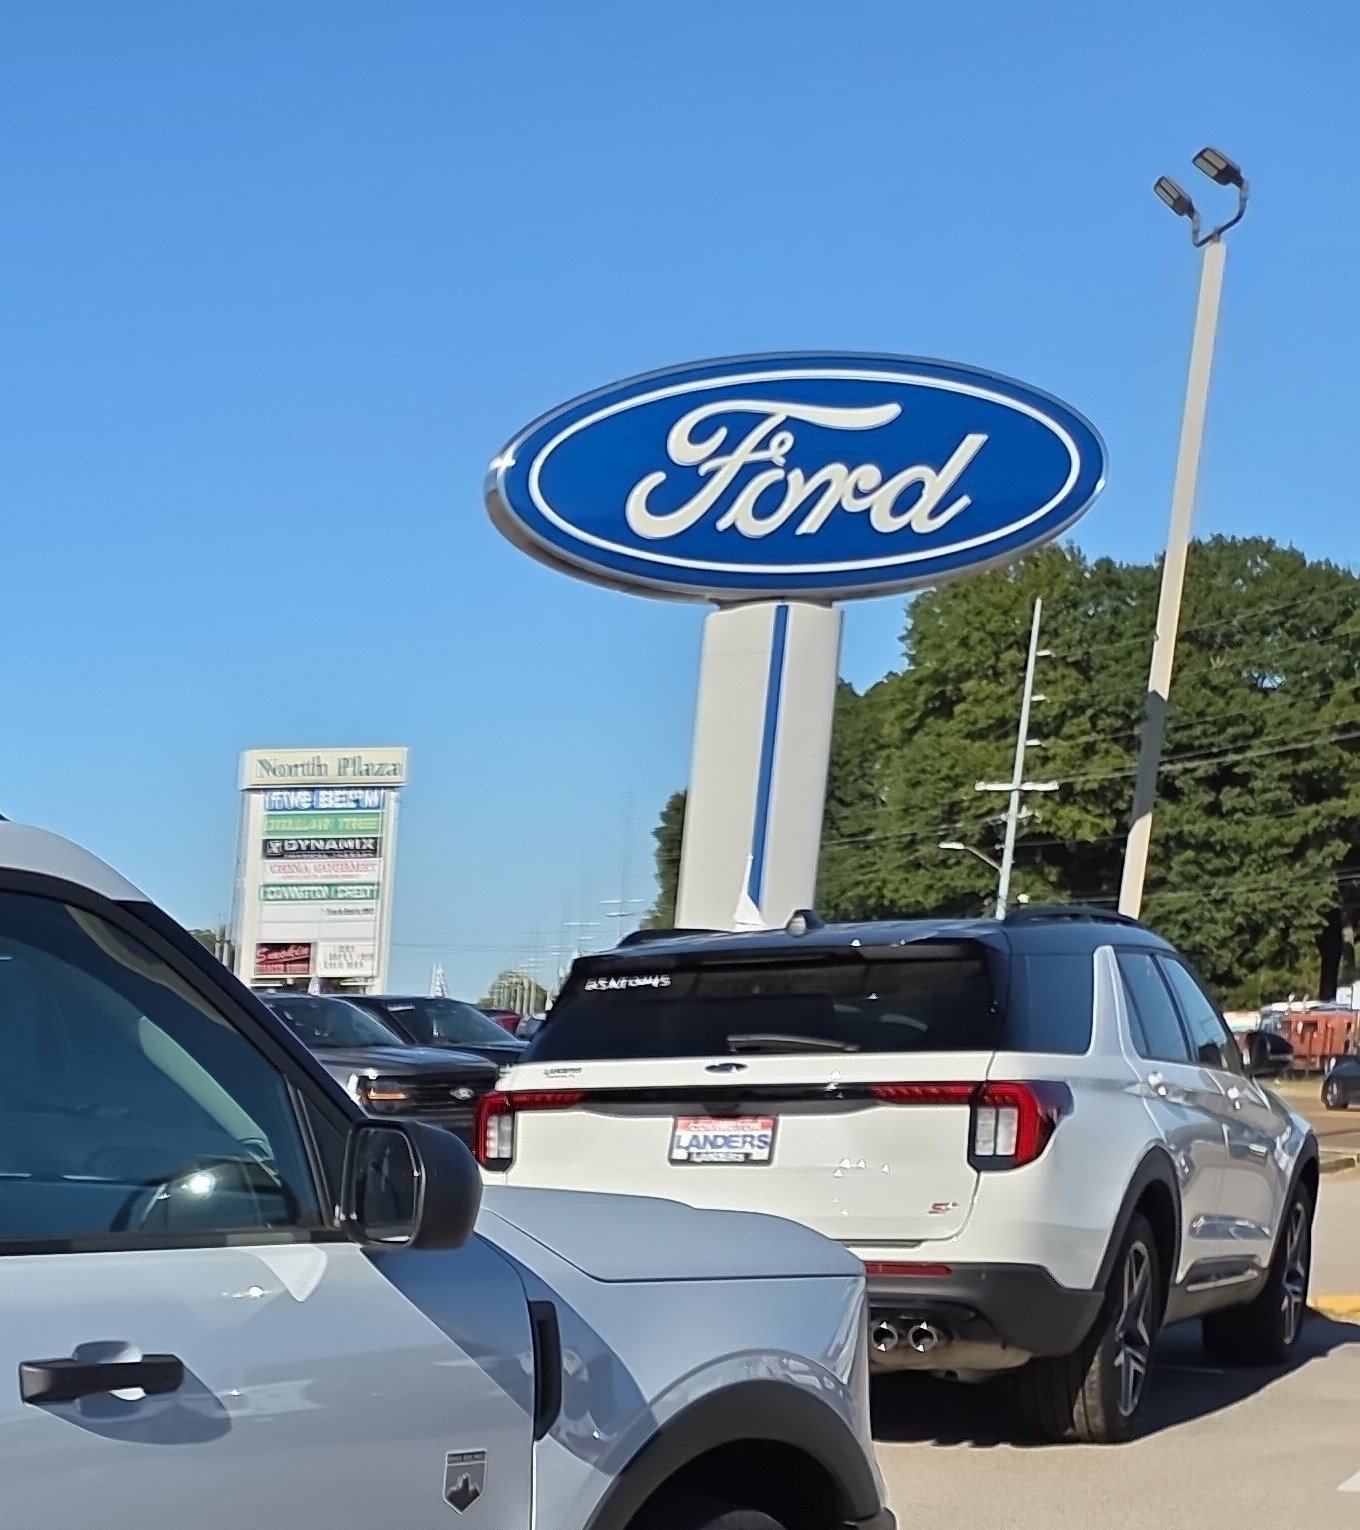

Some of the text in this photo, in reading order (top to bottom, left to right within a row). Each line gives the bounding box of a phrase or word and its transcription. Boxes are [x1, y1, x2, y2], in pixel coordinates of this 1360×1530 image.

[625, 400, 989, 541] Ford
[256, 756, 403, 778] North Plaza
[267, 817, 379, 832] DOLLAR TREE
[284, 838, 376, 851] DYNAMIX
[675, 1134, 771, 1150] LANDERS
